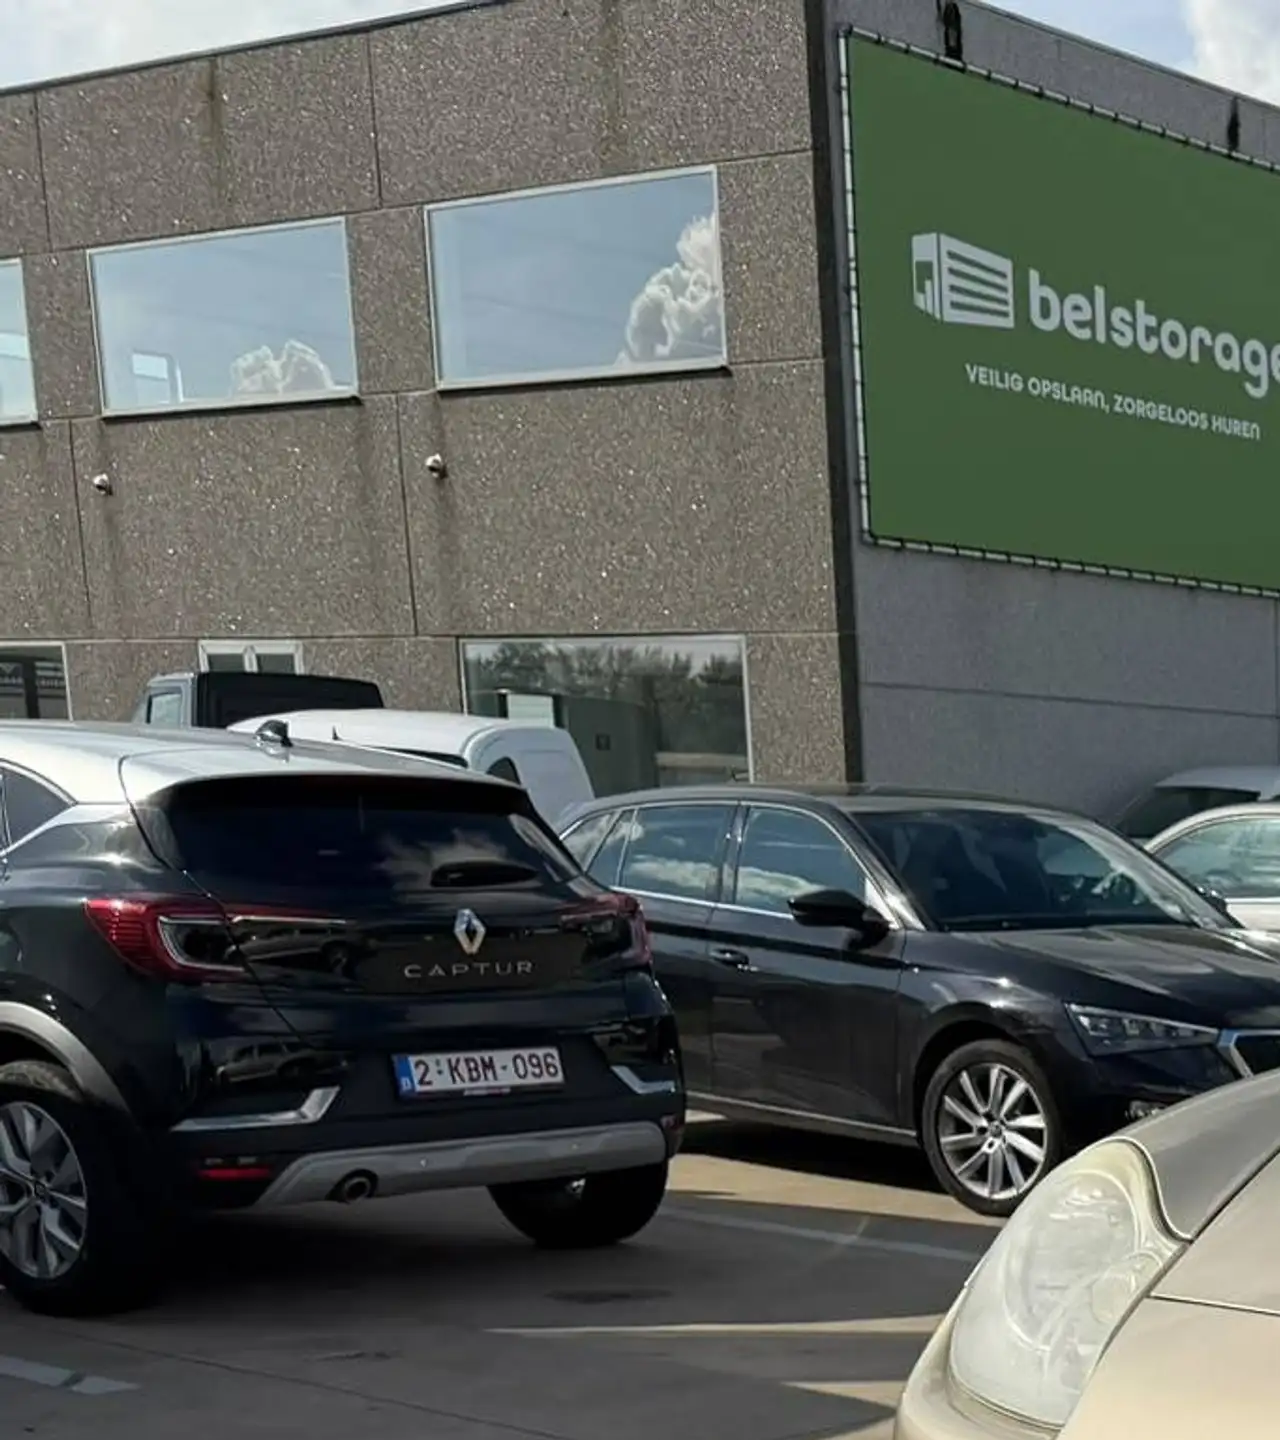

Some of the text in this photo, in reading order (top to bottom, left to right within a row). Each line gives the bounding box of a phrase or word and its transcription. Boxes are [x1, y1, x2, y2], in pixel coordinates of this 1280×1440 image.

[965, 363, 1260, 440] VEILIG OPSLAAN, ZORGELOOS HUREN
[403, 961, 534, 978] CAPTUR
